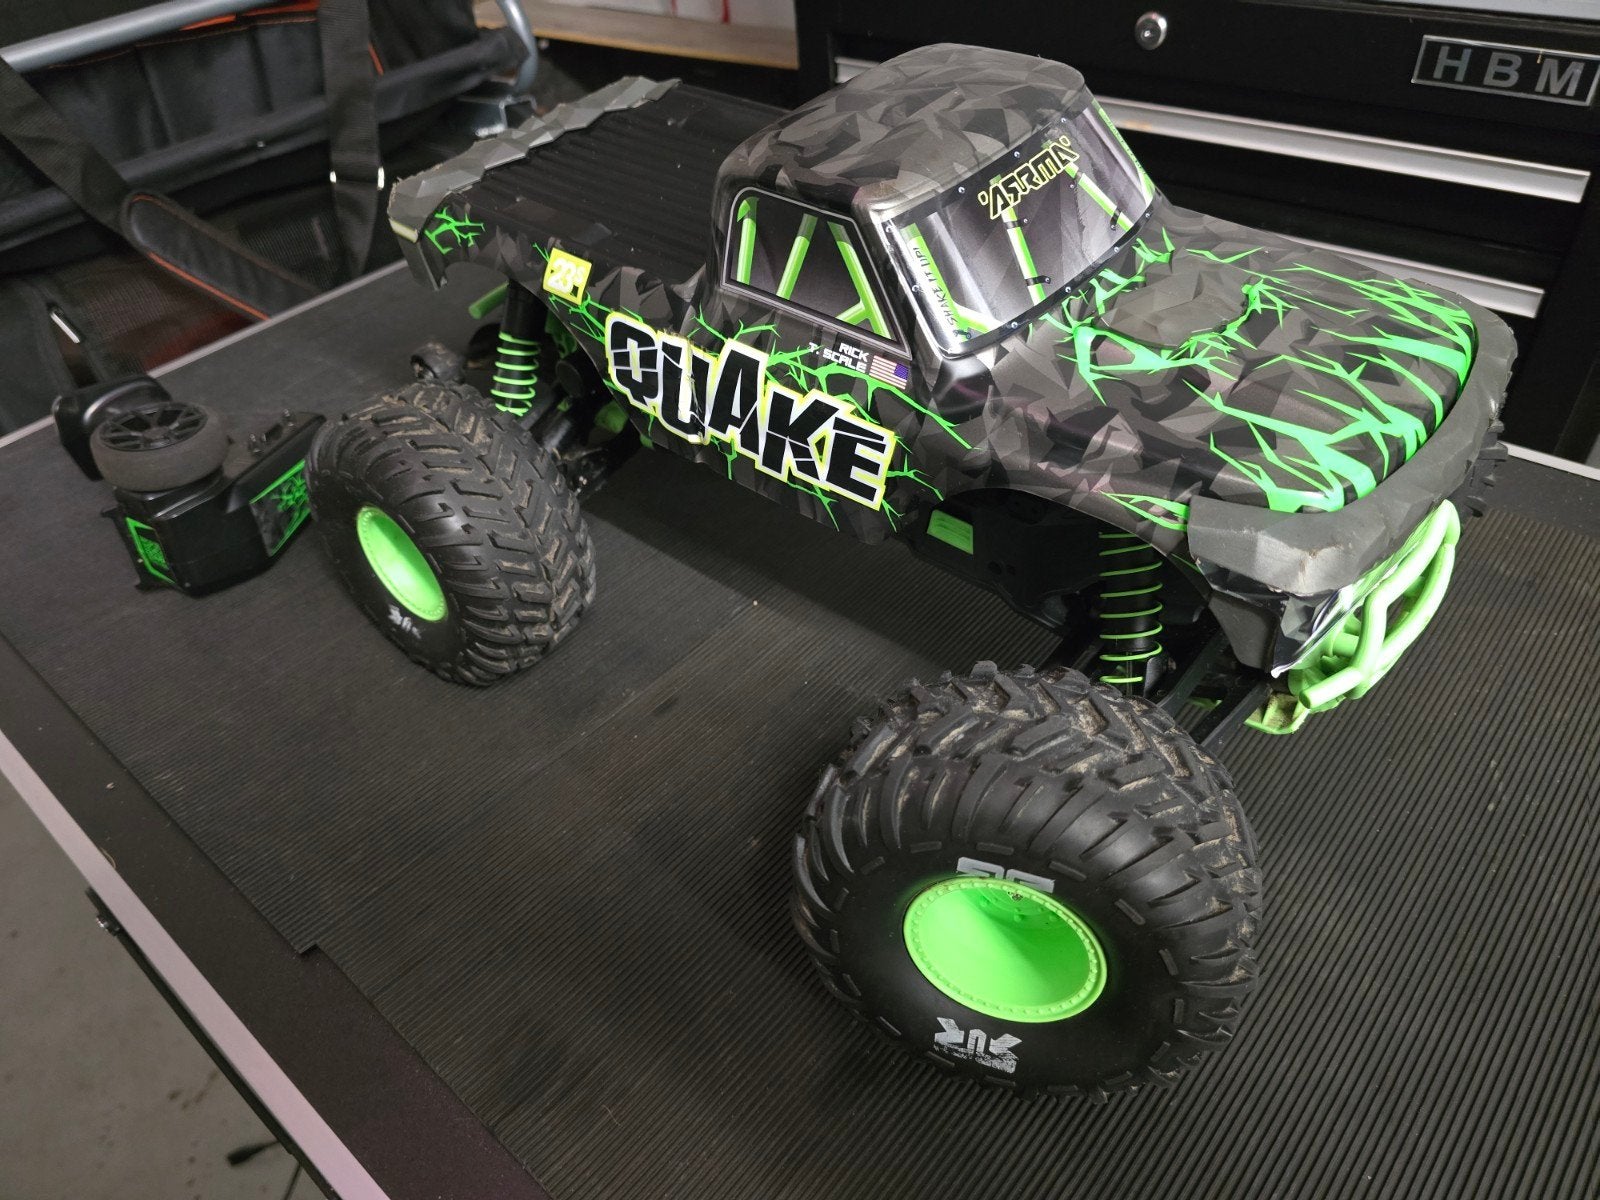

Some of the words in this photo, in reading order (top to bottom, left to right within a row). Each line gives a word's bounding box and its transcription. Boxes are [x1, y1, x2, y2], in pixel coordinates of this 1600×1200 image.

[1432, 45, 1586, 97] HBM
[923, 270, 938, 283] IT
[933, 286, 958, 326] SHAKE
[822, 347, 868, 374] SCALE
[838, 342, 869, 363] RICK
[607, 314, 893, 509] QUAKE
